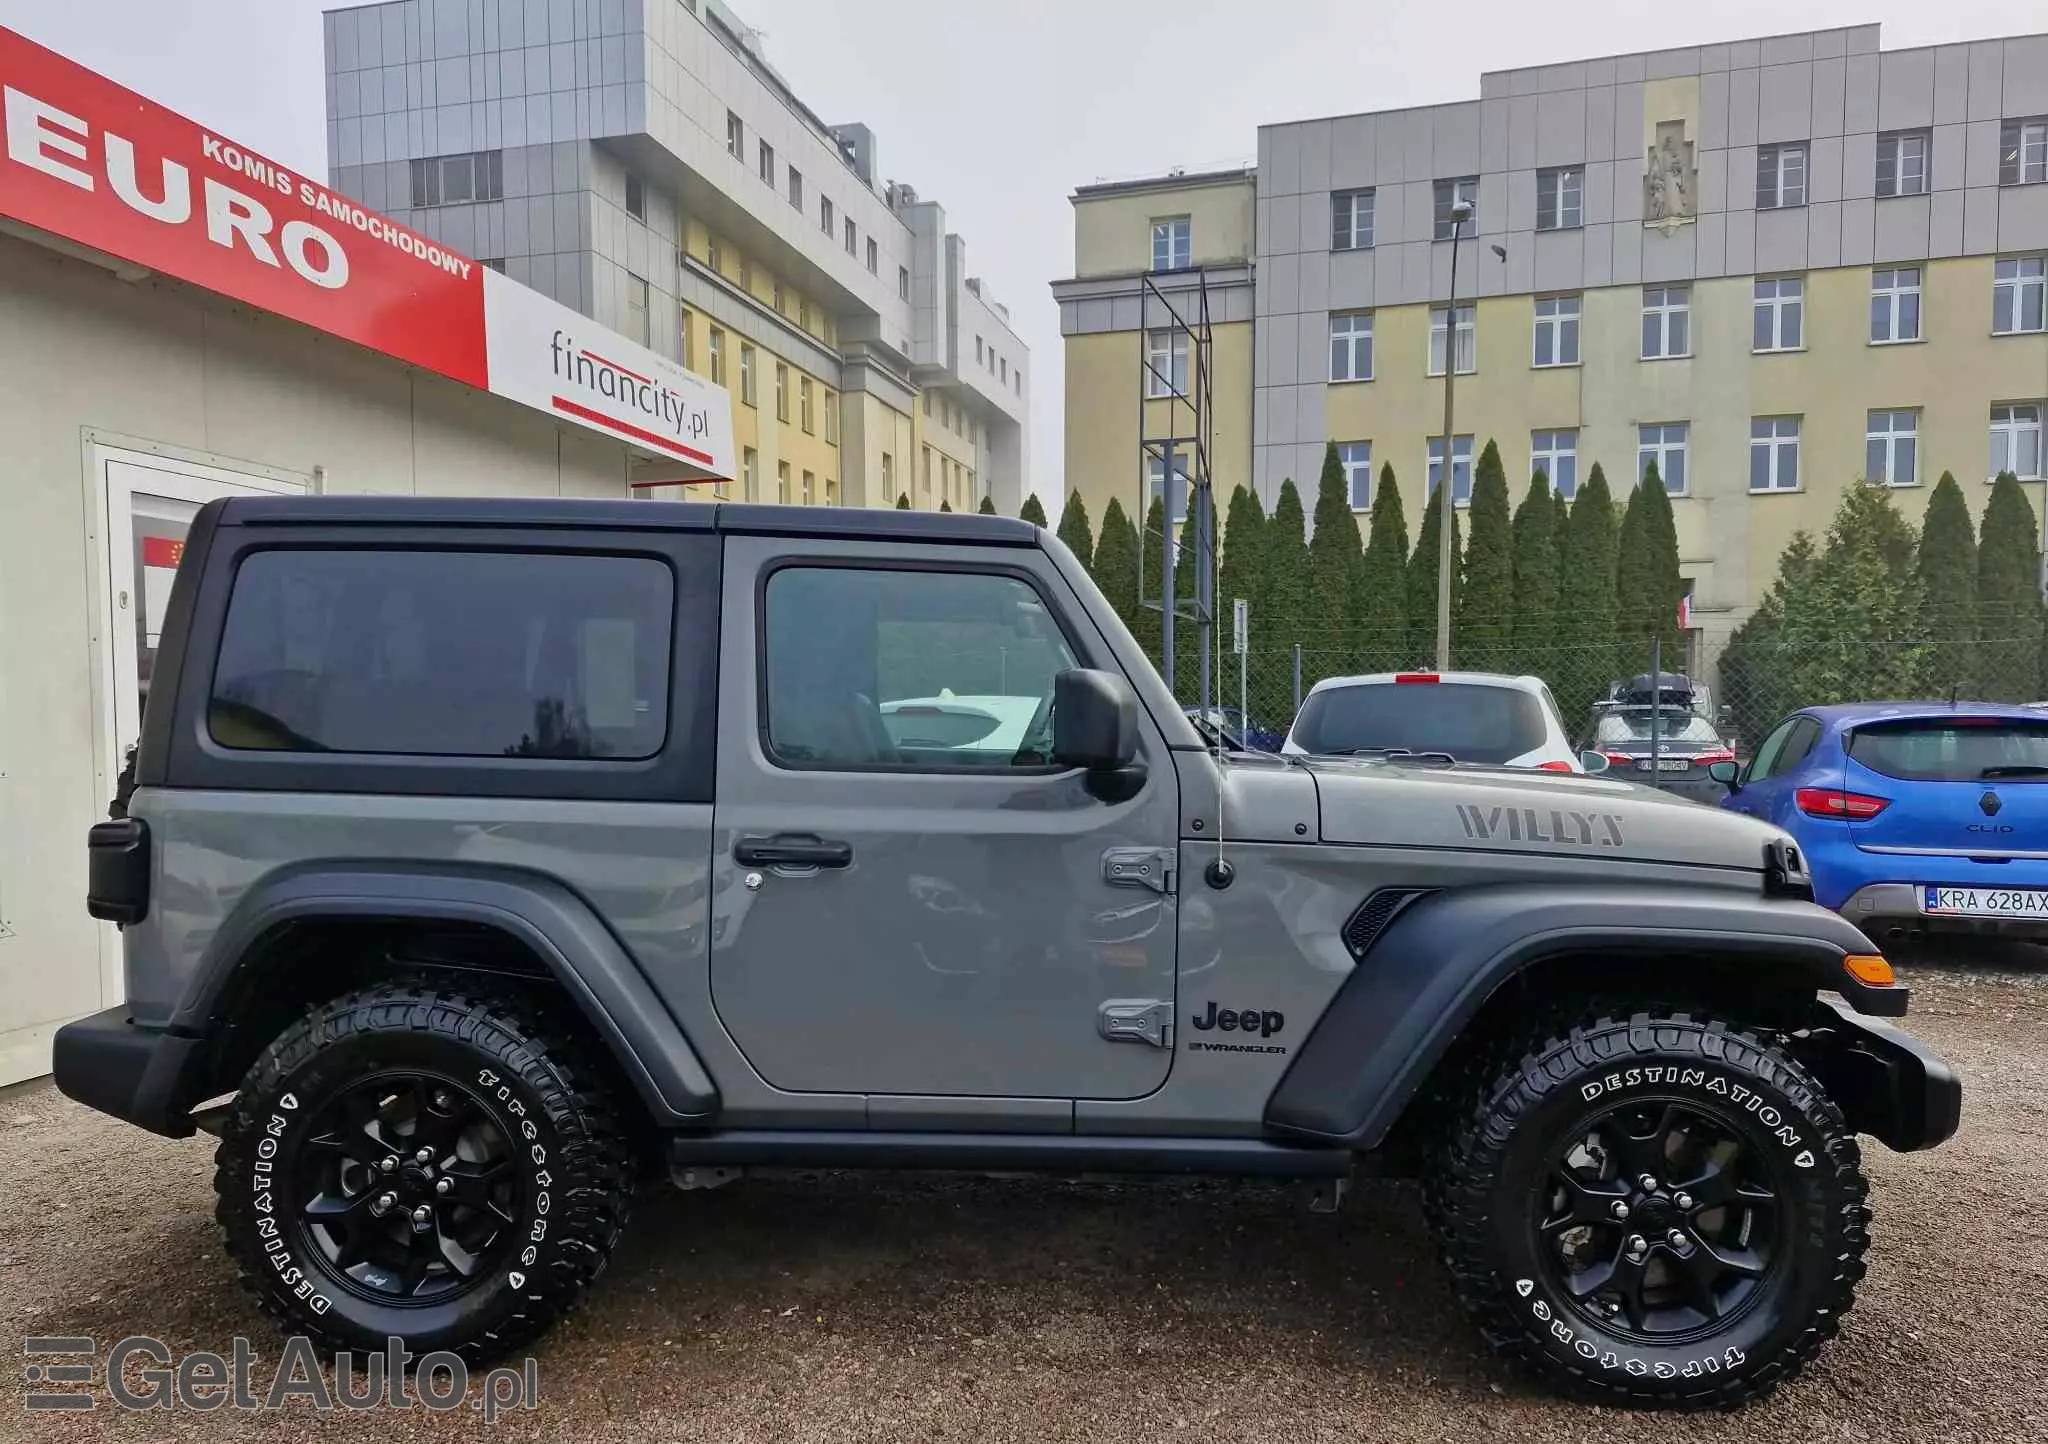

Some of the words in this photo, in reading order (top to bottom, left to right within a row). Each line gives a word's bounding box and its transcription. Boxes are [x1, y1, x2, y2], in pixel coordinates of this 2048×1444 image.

[3, 85, 349, 289] EURO
[202, 134, 292, 195] KOMIS
[300, 183, 471, 281] SAMOCHODOWY
[551, 331, 708, 439] financity.pl
[1455, 804, 1624, 847] WILLYS
[1965, 823, 2014, 833] CLIO
[1939, 889, 1978, 908] KRA
[1986, 892, 2048, 912] 628AX
[1192, 1001, 1285, 1038] Jeep
[1203, 1043, 1287, 1055] WRANGLER
[1581, 1067, 1801, 1147] DESTINATION
[254, 1114, 332, 1315] DESTINATION
